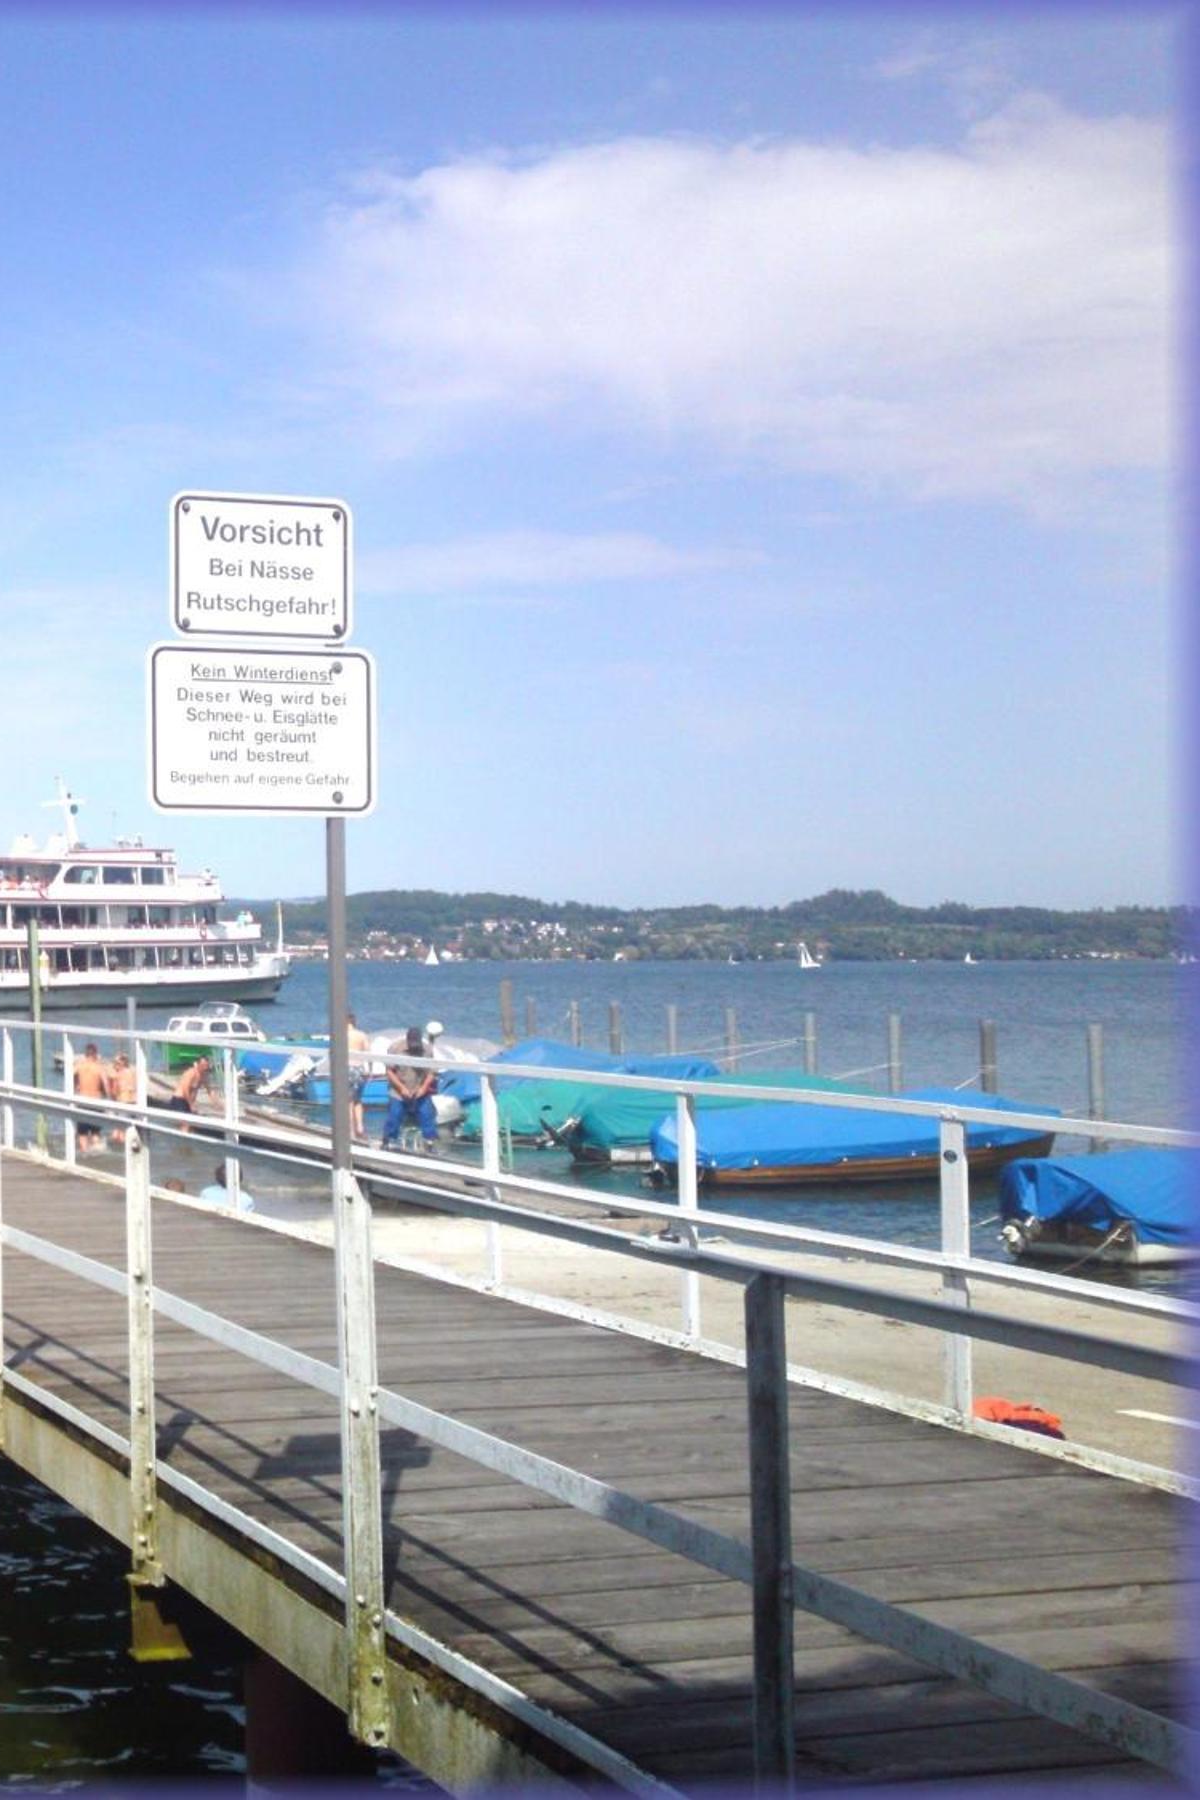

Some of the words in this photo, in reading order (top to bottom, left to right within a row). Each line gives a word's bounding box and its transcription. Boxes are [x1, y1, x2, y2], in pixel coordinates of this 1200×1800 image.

[200, 515, 324, 547] Vorsicht
[209, 557, 243, 577] Bei
[250, 559, 314, 581] Nässe
[186, 591, 337, 617] Rutschgefahr!
[190, 663, 226, 678] Kein
[233, 664, 334, 681] Winterdienst
[177, 686, 230, 703] Dieser
[239, 688, 273, 706] Weg
[280, 691, 314, 705] wird
[321, 692, 347, 706] bei
[186, 706, 250, 722] Schnee-
[273, 709, 339, 727] Eisglätte
[208, 728, 245, 742] nicht
[254, 730, 317, 745] geräumt
[210, 747, 238, 762] und
[170, 770, 230, 785] Begehen
[234, 772, 254, 784] auf
[258, 774, 303, 786] eigene
